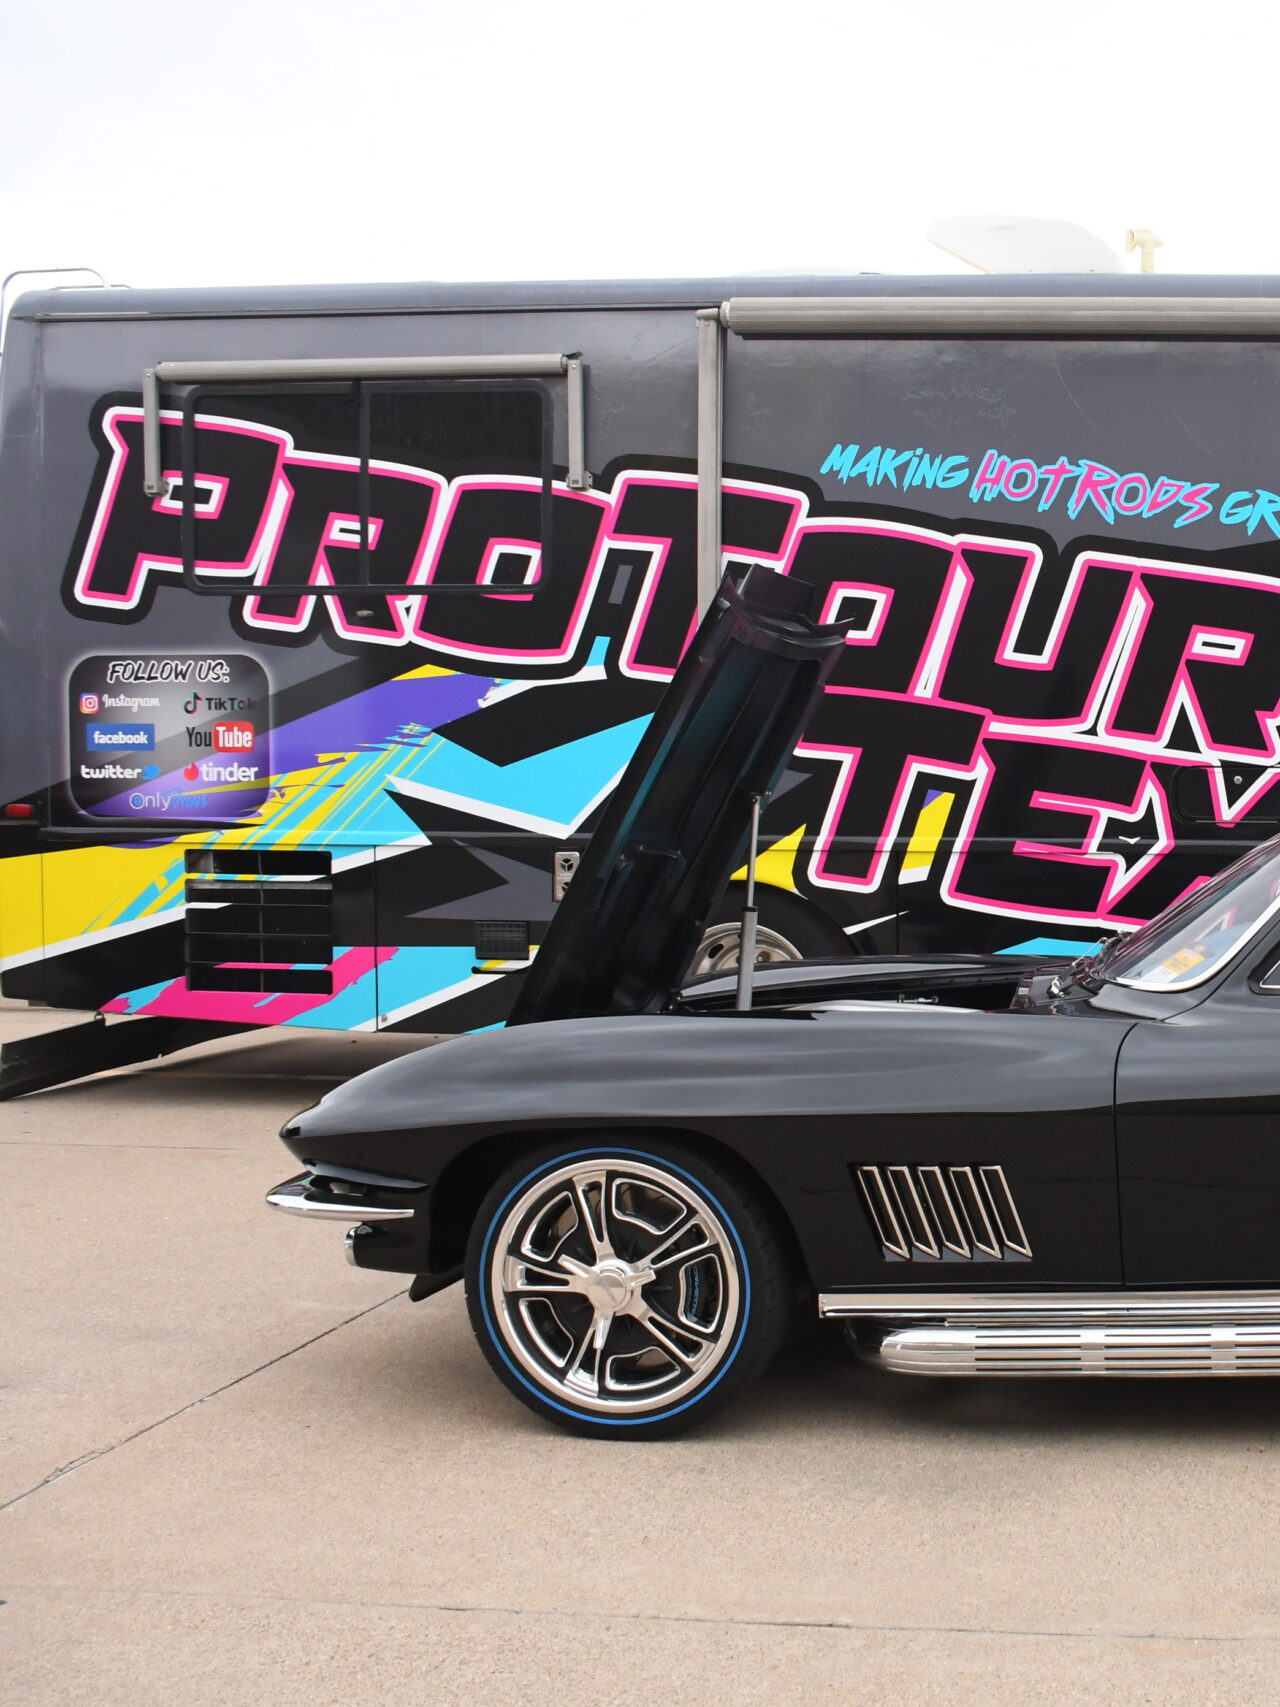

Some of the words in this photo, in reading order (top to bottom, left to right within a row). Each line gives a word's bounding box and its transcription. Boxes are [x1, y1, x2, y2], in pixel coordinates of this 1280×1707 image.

[107, 660, 193, 683] FOLLOW
[197, 659, 230, 683] US:
[102, 694, 160, 712] Instagram
[205, 697, 256, 711] TikTok
[93, 730, 148, 745] facebook
[186, 726, 253, 748] YouTube
[80, 764, 142, 780] twitter
[201, 762, 259, 782] tinder
